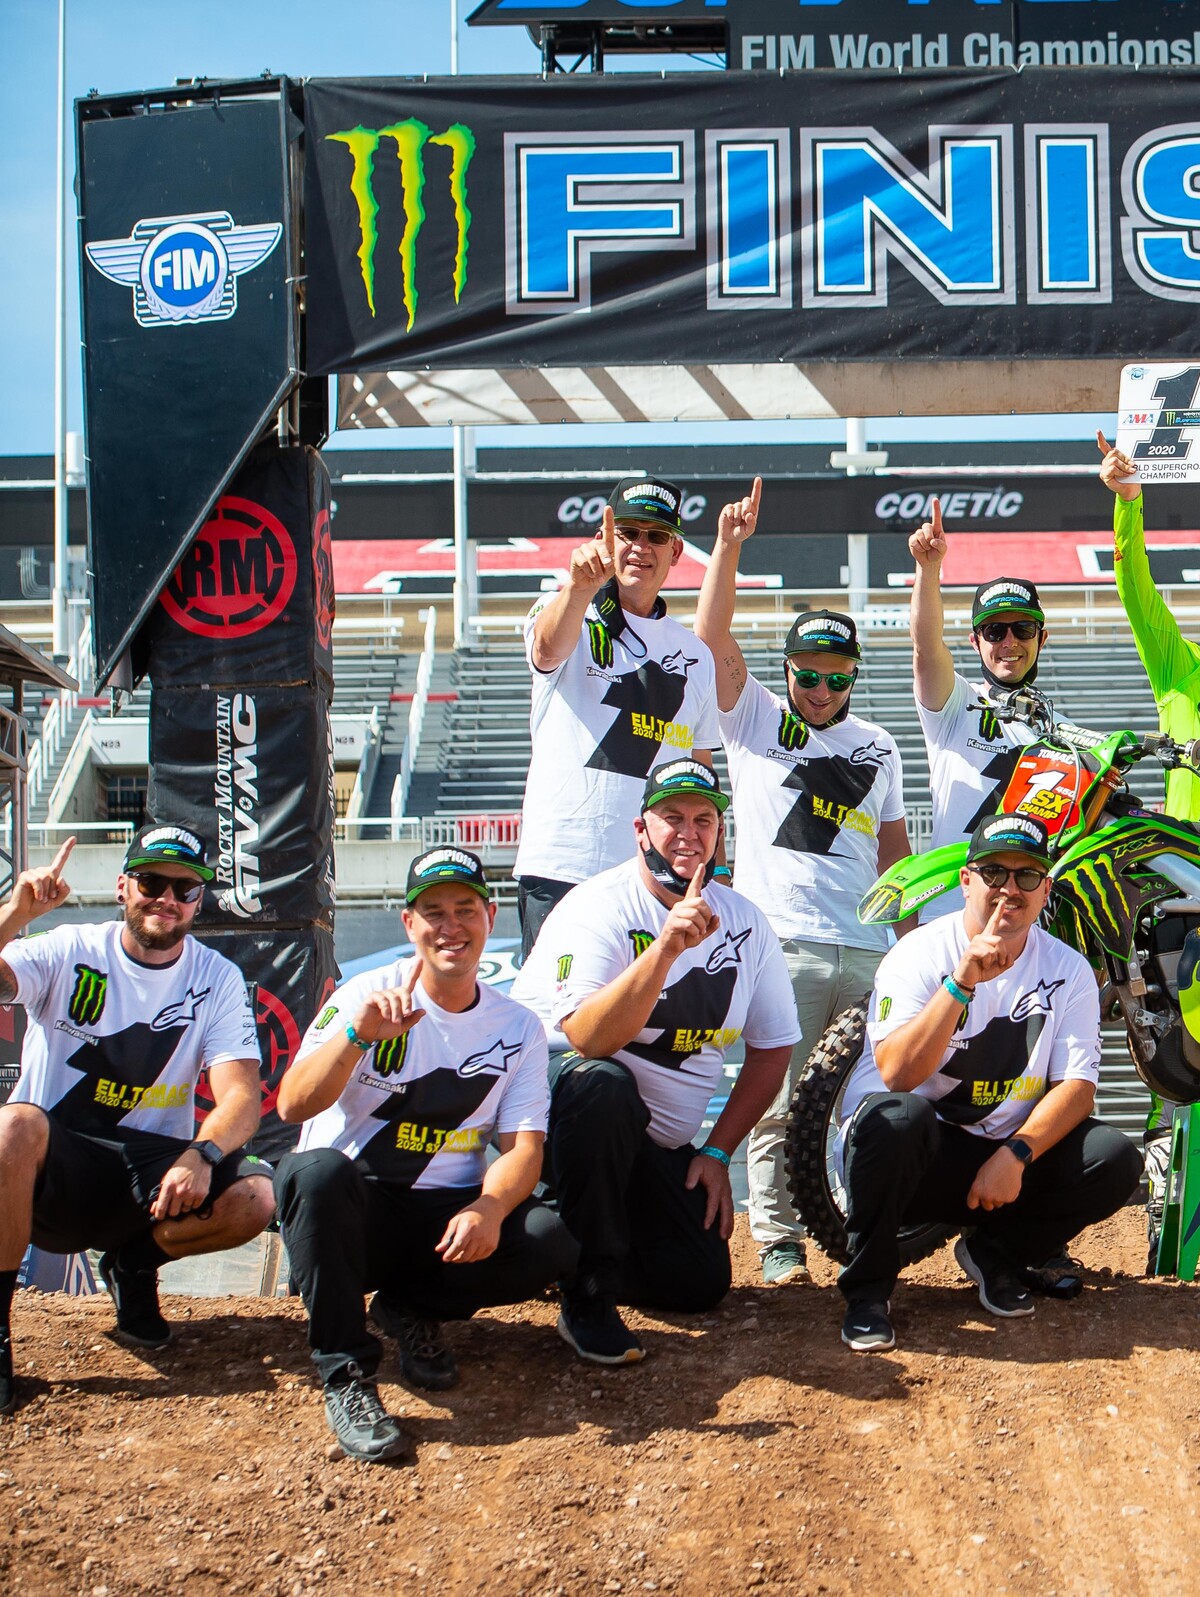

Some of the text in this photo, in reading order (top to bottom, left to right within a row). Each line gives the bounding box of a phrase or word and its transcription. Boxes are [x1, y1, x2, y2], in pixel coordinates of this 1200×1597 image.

[742, 34, 816, 70] FIM
[829, 33, 949, 69] World
[152, 257, 215, 292] FIM
[1147, 445, 1176, 455] 2020
[1140, 472, 1187, 480] CHAMPION
[623, 484, 677, 511] CHAMPIONS
[183, 537, 272, 597] RM
[798, 618, 851, 640] CHAMPIONS
[631, 712, 655, 732] ELI
[632, 727, 653, 739] 2020
[215, 695, 233, 812] MOUNTAIN
[967, 738, 1009, 754] Kawasaki
[766, 749, 809, 767] Kawasaki
[1038, 749, 1076, 765] TOMAC
[1015, 770, 1067, 815] 1
[1031, 790, 1071, 813] SX
[1018, 802, 1058, 820] CHAMP
[983, 817, 1043, 843] CHAMPIONS
[216, 813, 233, 885] ROCKY
[54, 1020, 99, 1047] Kawasaki
[97, 1078, 191, 1101] ELI TOMAC
[358, 1073, 406, 1094] Kawasaki
[972, 1080, 998, 1097] ELI
[94, 1092, 135, 1110] 2020 SX
[971, 1096, 994, 1107] 2020
[398, 1121, 428, 1141] ELI
[395, 1138, 423, 1151] 2020
[425, 1142, 440, 1154] SX
